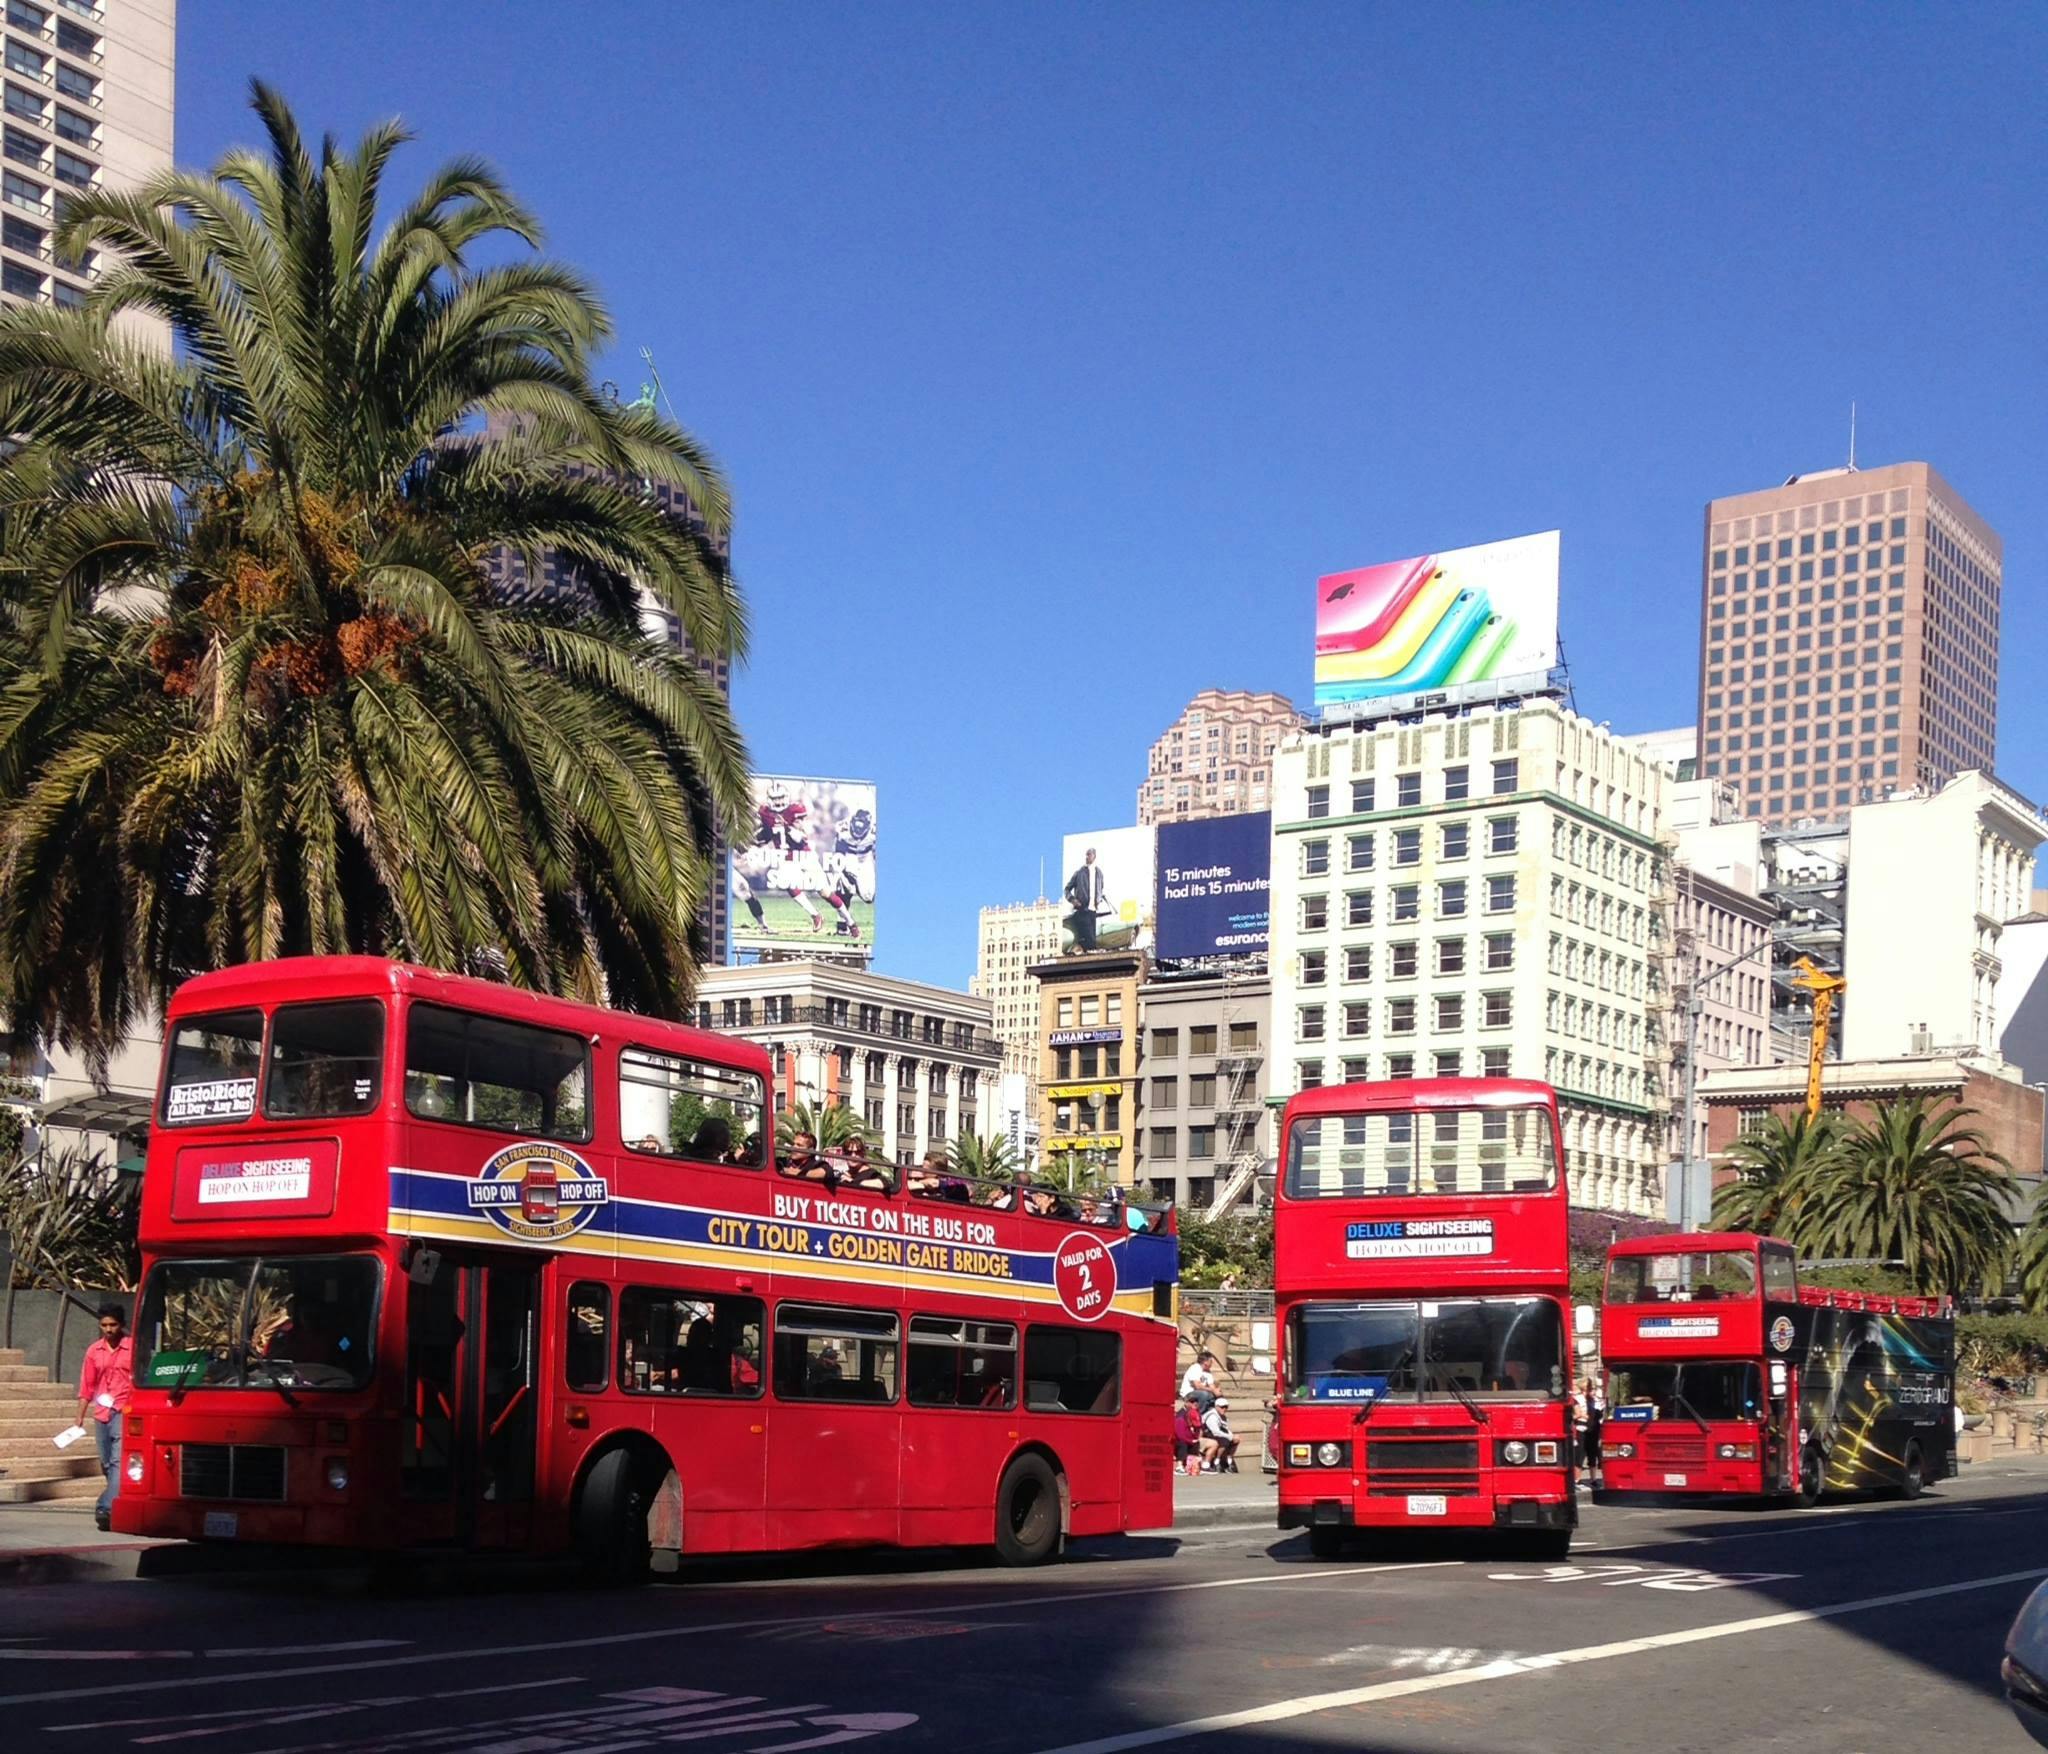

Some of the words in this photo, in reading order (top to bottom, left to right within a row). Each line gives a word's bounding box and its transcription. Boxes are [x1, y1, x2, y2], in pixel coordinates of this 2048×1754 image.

[1164, 869, 1179, 882] 15
[1182, 866, 1231, 881] minutes
[1165, 884, 1188, 899] had
[1191, 884, 1206, 896] its
[1208, 881, 1222, 895] 15
[1050, 1032, 1084, 1043] JAHAN
[173, 1083, 254, 1103] BristolRider
[171, 1102, 187, 1116] All
[188, 1101, 206, 1117] Day
[213, 1099, 231, 1114] Any
[234, 1098, 251, 1111] Bus
[1008, 1109, 1021, 1167] JOHNSTO
[242, 1158, 311, 1178] SIGHTSEEING
[494, 1155, 510, 1171] SAN
[509, 1146, 549, 1162] FRANCISCO
[550, 1149, 577, 1169] DELUXE
[208, 1181, 232, 1196] HOP
[233, 1180, 249, 1195] ON
[252, 1179, 276, 1193] HOP
[278, 1178, 299, 1192] OFF
[474, 1185, 498, 1202] HOP
[501, 1185, 517, 1201] ON
[561, 1184, 582, 1200] HOP
[584, 1183, 603, 1199] OFF
[509, 1222, 553, 1238] SIGHTSEEING
[554, 1221, 575, 1236] TOURS
[775, 1194, 810, 1219] BUY
[814, 1200, 867, 1227] TICKET
[871, 1208, 898, 1232] ON
[902, 1212, 929, 1236] THE
[934, 1217, 963, 1241] BUS
[967, 1222, 996, 1246] FOR
[1347, 1222, 1402, 1239] DELUXE
[1406, 1219, 1492, 1236] SIGHTSEEING
[707, 1217, 750, 1246] CITY
[755, 1222, 810, 1253] TOUR
[828, 1232, 901, 1265] GOLDEN
[906, 1243, 949, 1271] GATE
[953, 1250, 1013, 1277] BRIDGE.
[1355, 1243, 1388, 1256] HOP
[1390, 1243, 1412, 1254] ON
[1418, 1242, 1451, 1254] HOP
[1454, 1241, 1480, 1253] OFF
[1061, 1252, 1085, 1268] VALID
[1085, 1247, 1103, 1261] FOR
[1078, 1264, 1093, 1291] 2
[1076, 1290, 1101, 1311] DAYS
[155, 1364, 180, 1376] GREEN
[1328, 1388, 1353, 1397] BLUE
[1353, 1388, 1375, 1397] LINE
[1487, 1565, 1803, 1592] BUS
